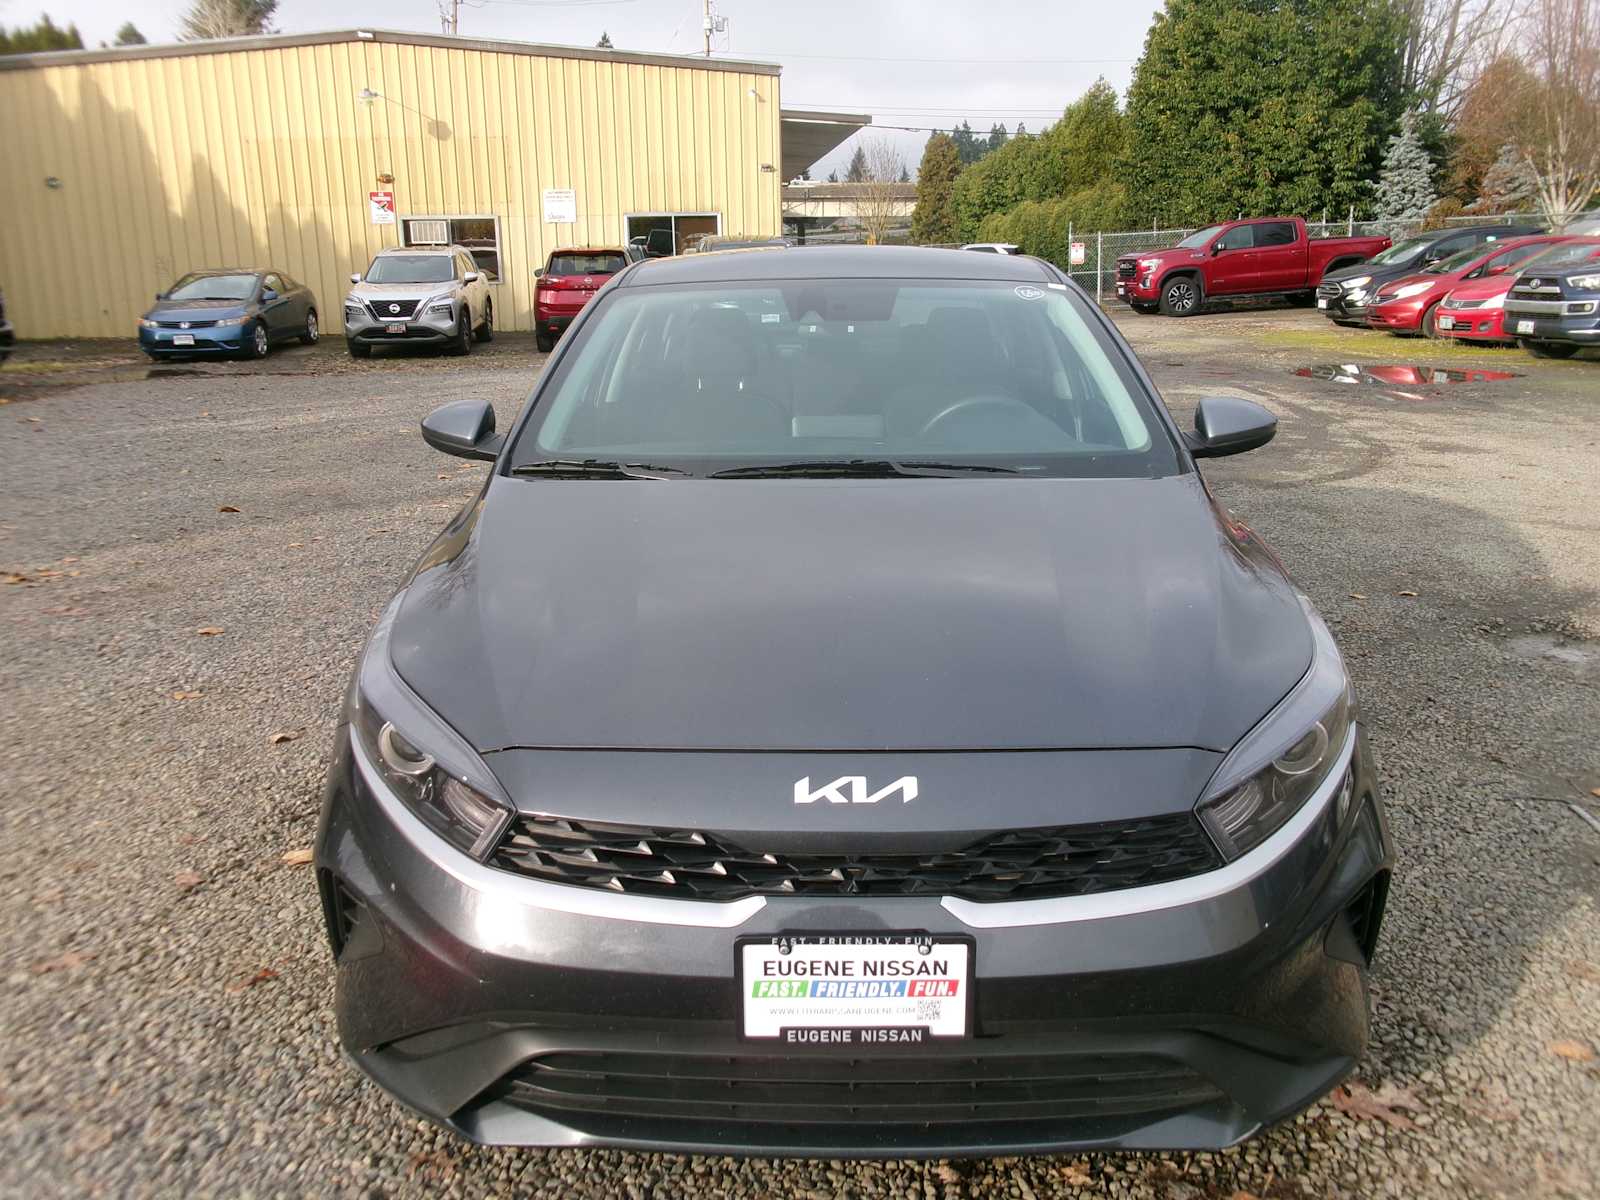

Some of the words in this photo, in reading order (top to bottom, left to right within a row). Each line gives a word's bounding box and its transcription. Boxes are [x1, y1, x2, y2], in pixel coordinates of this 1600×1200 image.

[763, 960, 854, 976] EUGENE
[863, 960, 948, 976] NISSAN
[758, 981, 804, 997] FAST.
[816, 981, 902, 997] FRIENDLY.
[914, 980, 954, 996] FUN.
[787, 1030, 852, 1043] EUGENE
[861, 1030, 922, 1042] NISSAN
